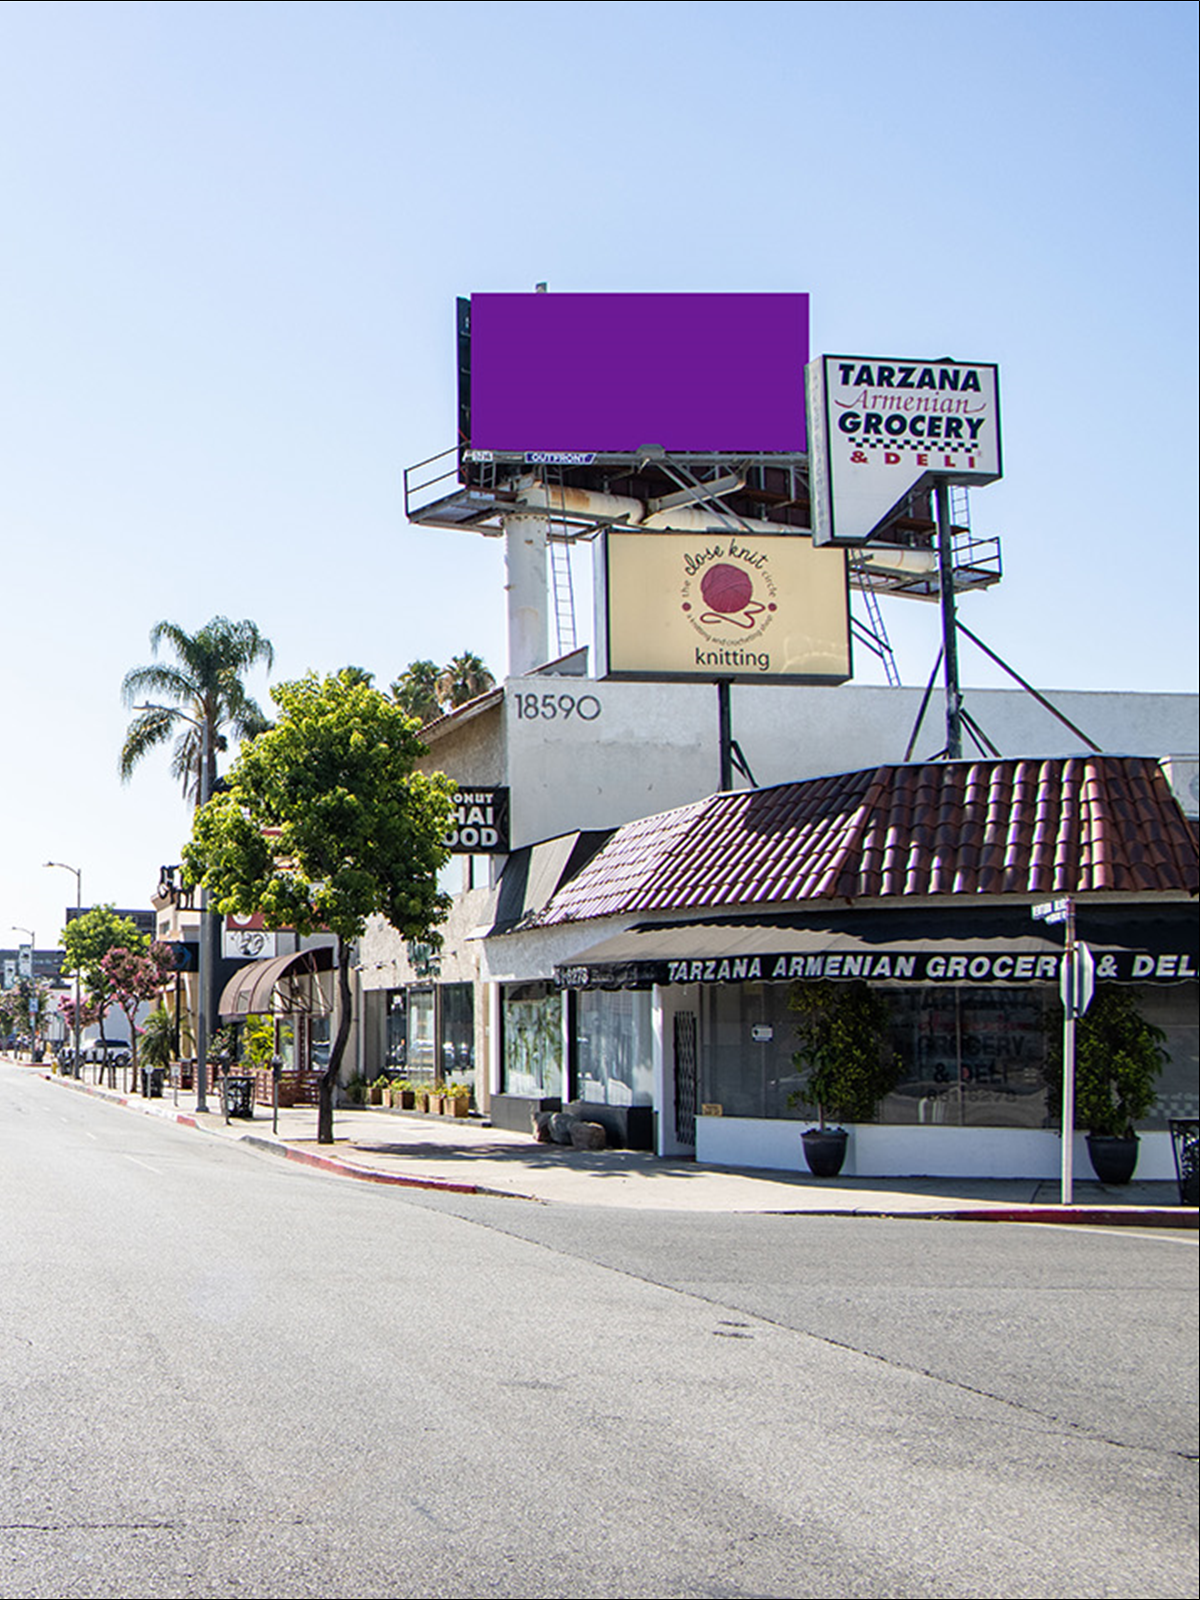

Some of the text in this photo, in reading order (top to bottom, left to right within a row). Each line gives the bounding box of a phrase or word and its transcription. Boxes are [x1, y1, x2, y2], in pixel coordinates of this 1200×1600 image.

[839, 363, 981, 392] TARZANA
[834, 390, 986, 413] Armenian
[838, 411, 985, 440] GROCERY
[850, 450, 975, 468] & DELI
[684, 545, 724, 576] close
[728, 538, 768, 569] knit
[695, 647, 769, 671] knitting
[514, 693, 601, 721] 18590
[447, 793, 494, 804] ONUT
[447, 806, 493, 825] HAI
[440, 827, 498, 847] OOD
[667, 954, 1199, 981] TARZANA ARMENIAN GROCER & DEL
